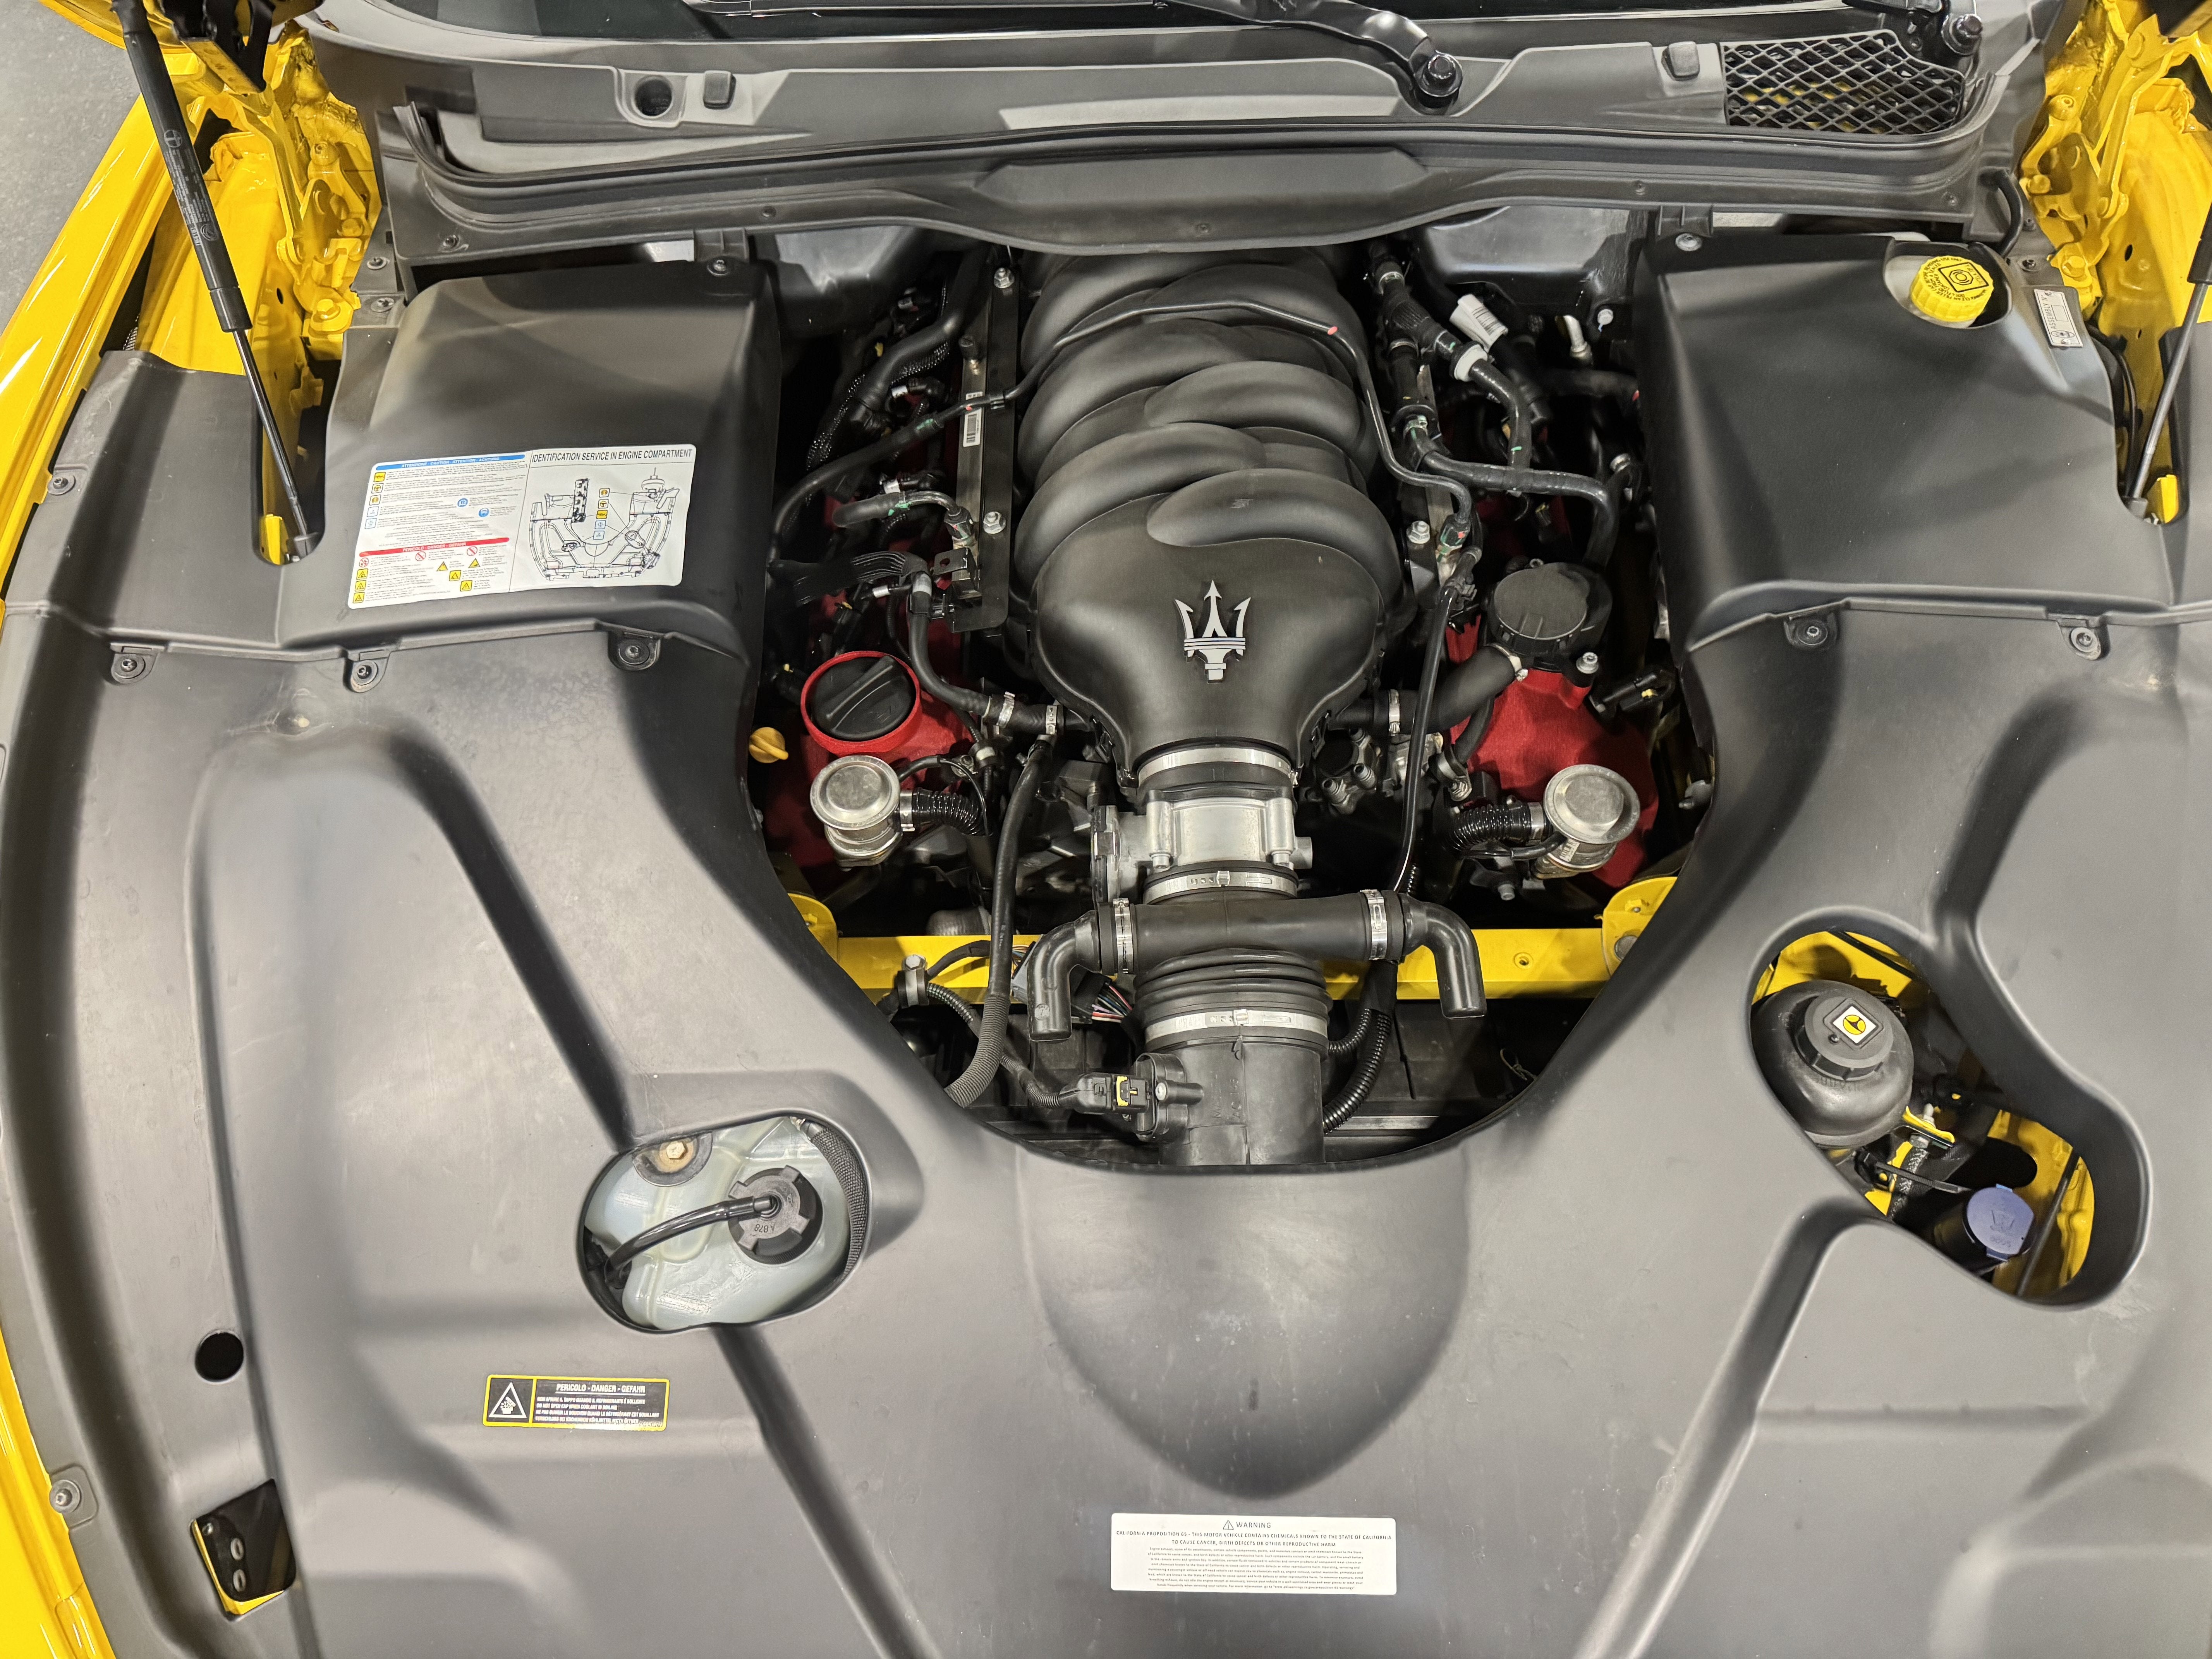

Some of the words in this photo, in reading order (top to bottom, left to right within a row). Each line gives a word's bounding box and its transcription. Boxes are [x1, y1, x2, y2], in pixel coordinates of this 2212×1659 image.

[2044, 303, 2057, 329] ASSEMBLY
[532, 452, 580, 462] IDENTIFICATION
[582, 451, 609, 460] SERVICE
[618, 450, 642, 459] ENGINE
[643, 449, 693, 459] COMPARTMENT
[556, 1383, 586, 1392] PERICOLO
